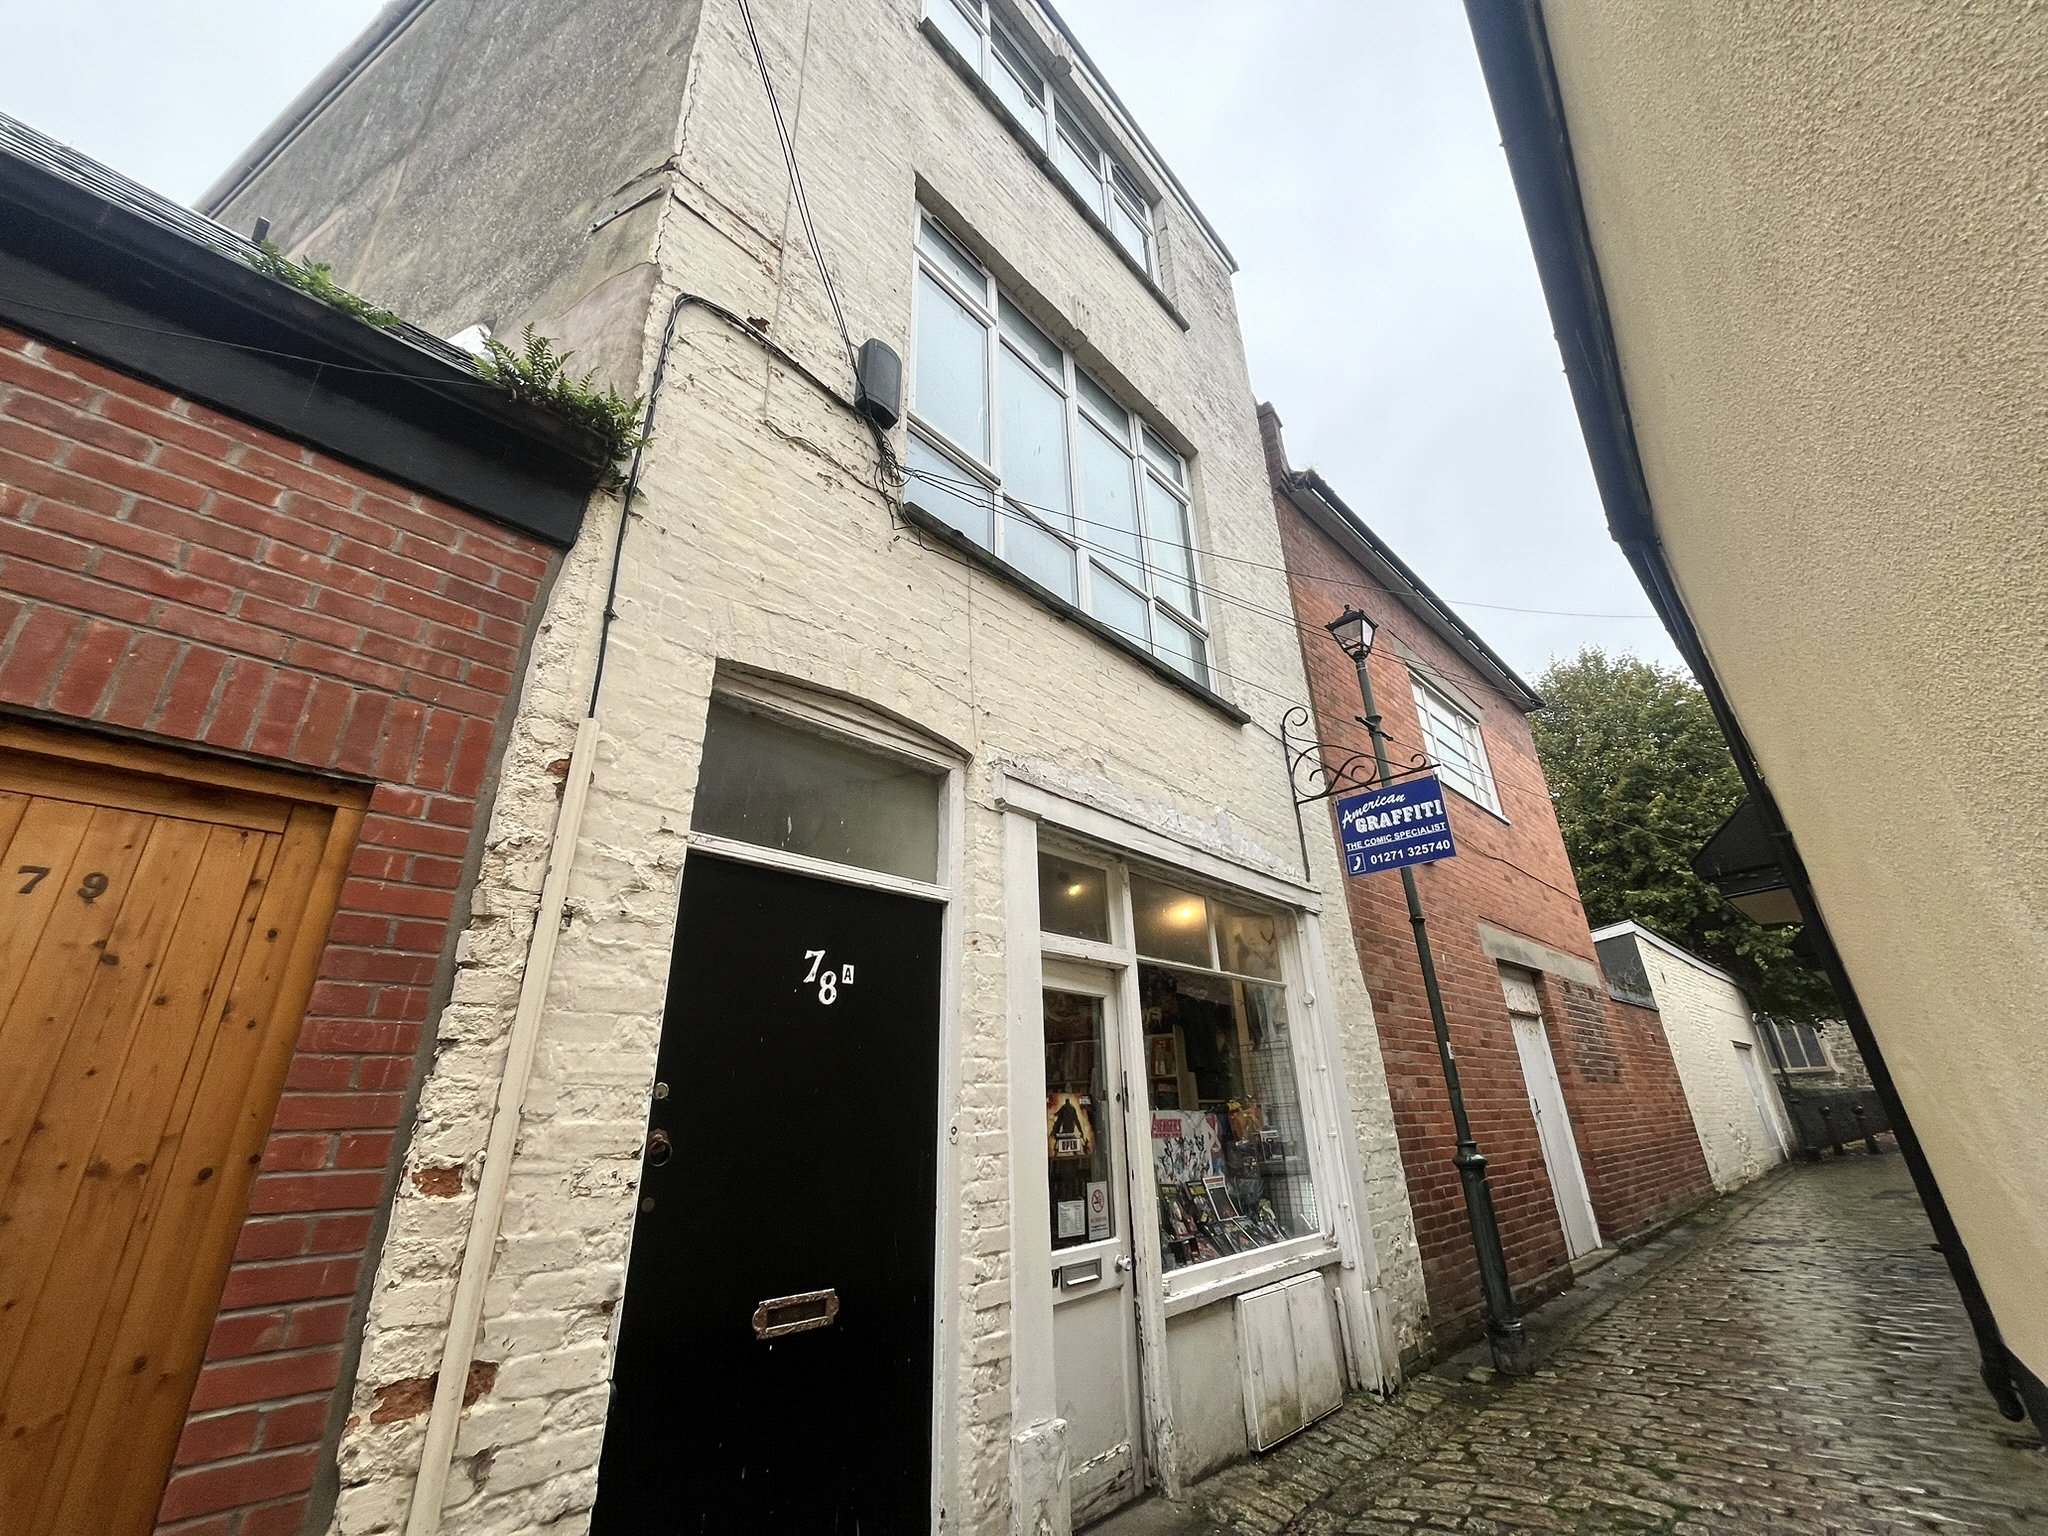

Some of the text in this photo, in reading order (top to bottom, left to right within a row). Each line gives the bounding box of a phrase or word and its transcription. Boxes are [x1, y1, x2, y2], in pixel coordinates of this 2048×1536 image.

[1342, 793, 1406, 829] American
[1355, 799, 1443, 834] GRAFFITI
[1346, 822, 1446, 851] THE COMIC SPECIALIST
[1370, 840, 1451, 865] 01271 325740
